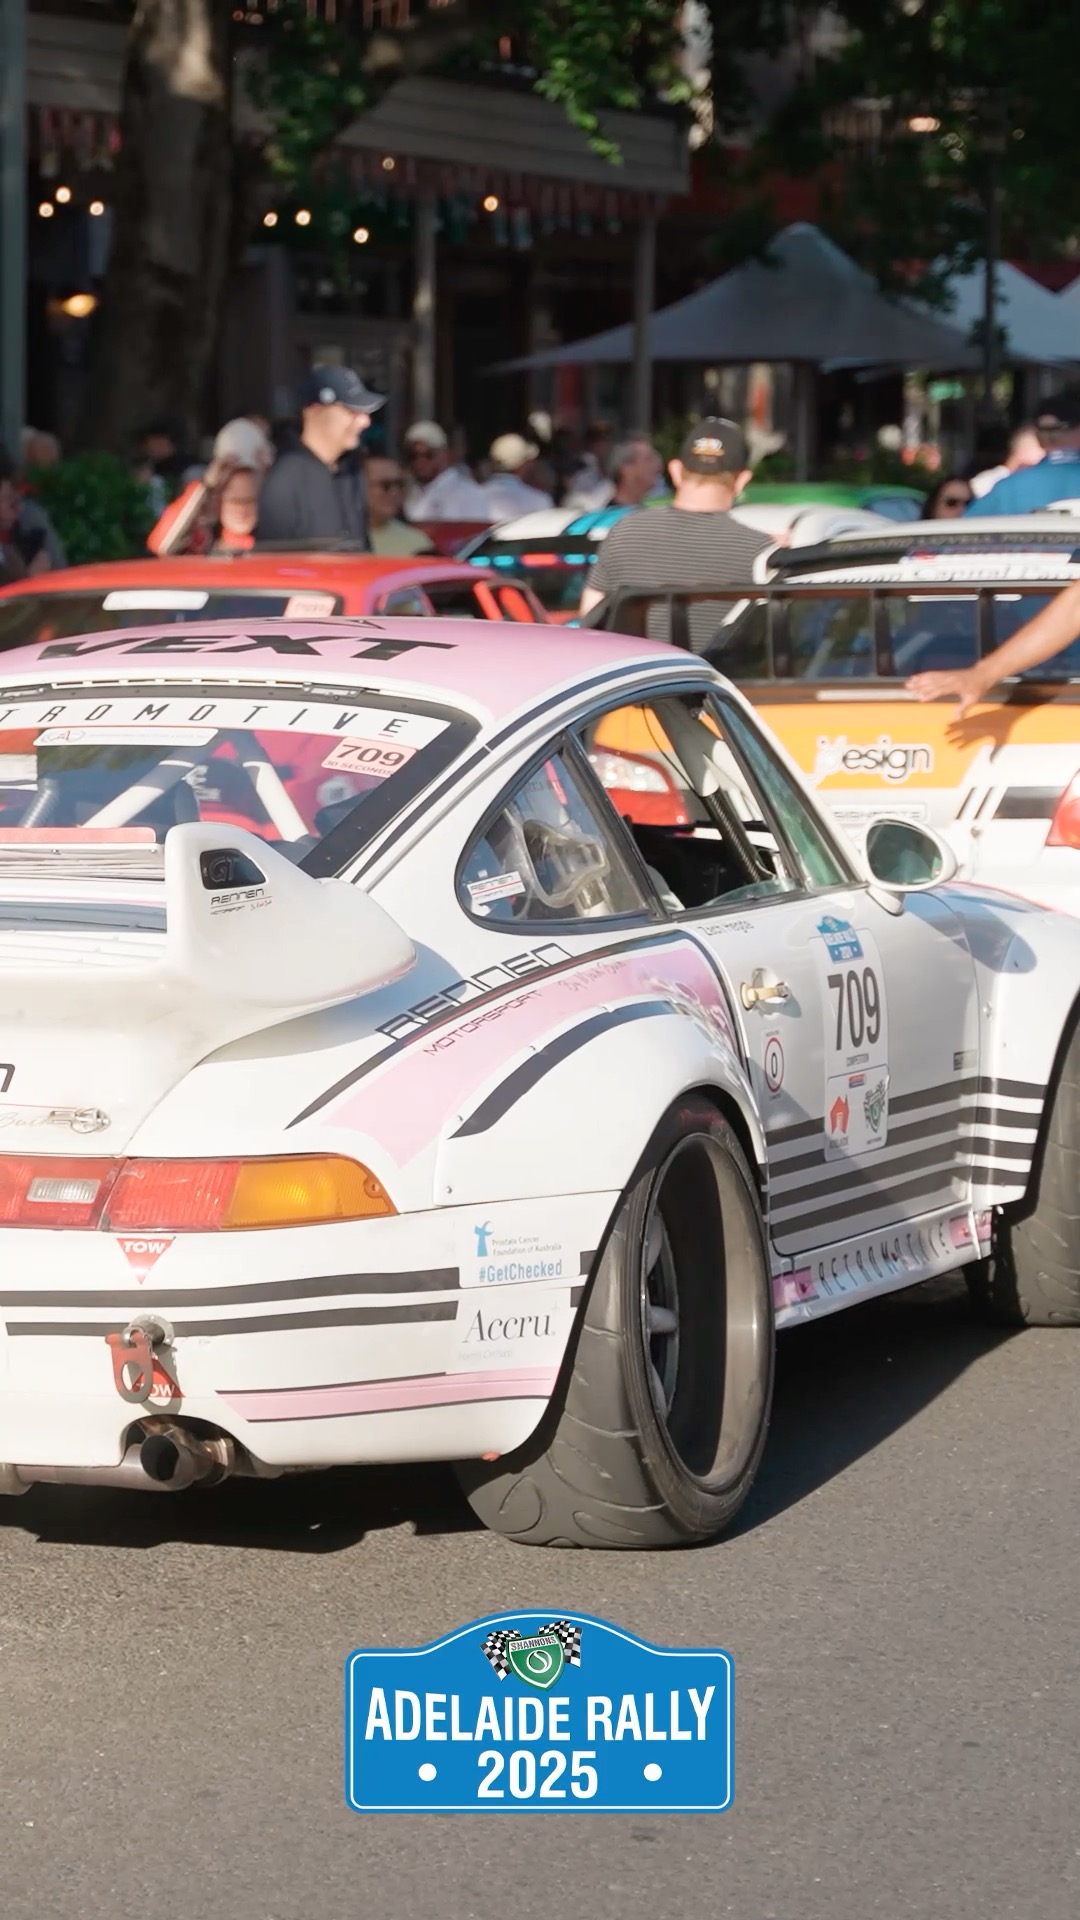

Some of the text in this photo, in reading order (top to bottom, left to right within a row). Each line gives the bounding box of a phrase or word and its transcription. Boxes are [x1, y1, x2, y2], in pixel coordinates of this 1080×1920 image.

[37, 635, 459, 661] VEXT
[336, 744, 405, 767] 709
[341, 762, 395, 775] SECONDS
[827, 967, 881, 1051] 709
[423, 989, 542, 1056] MOTORSPORT
[123, 1241, 166, 1254] TOW
[519, 1236, 540, 1244] Cancer
[479, 1259, 563, 1283] #GetChecked
